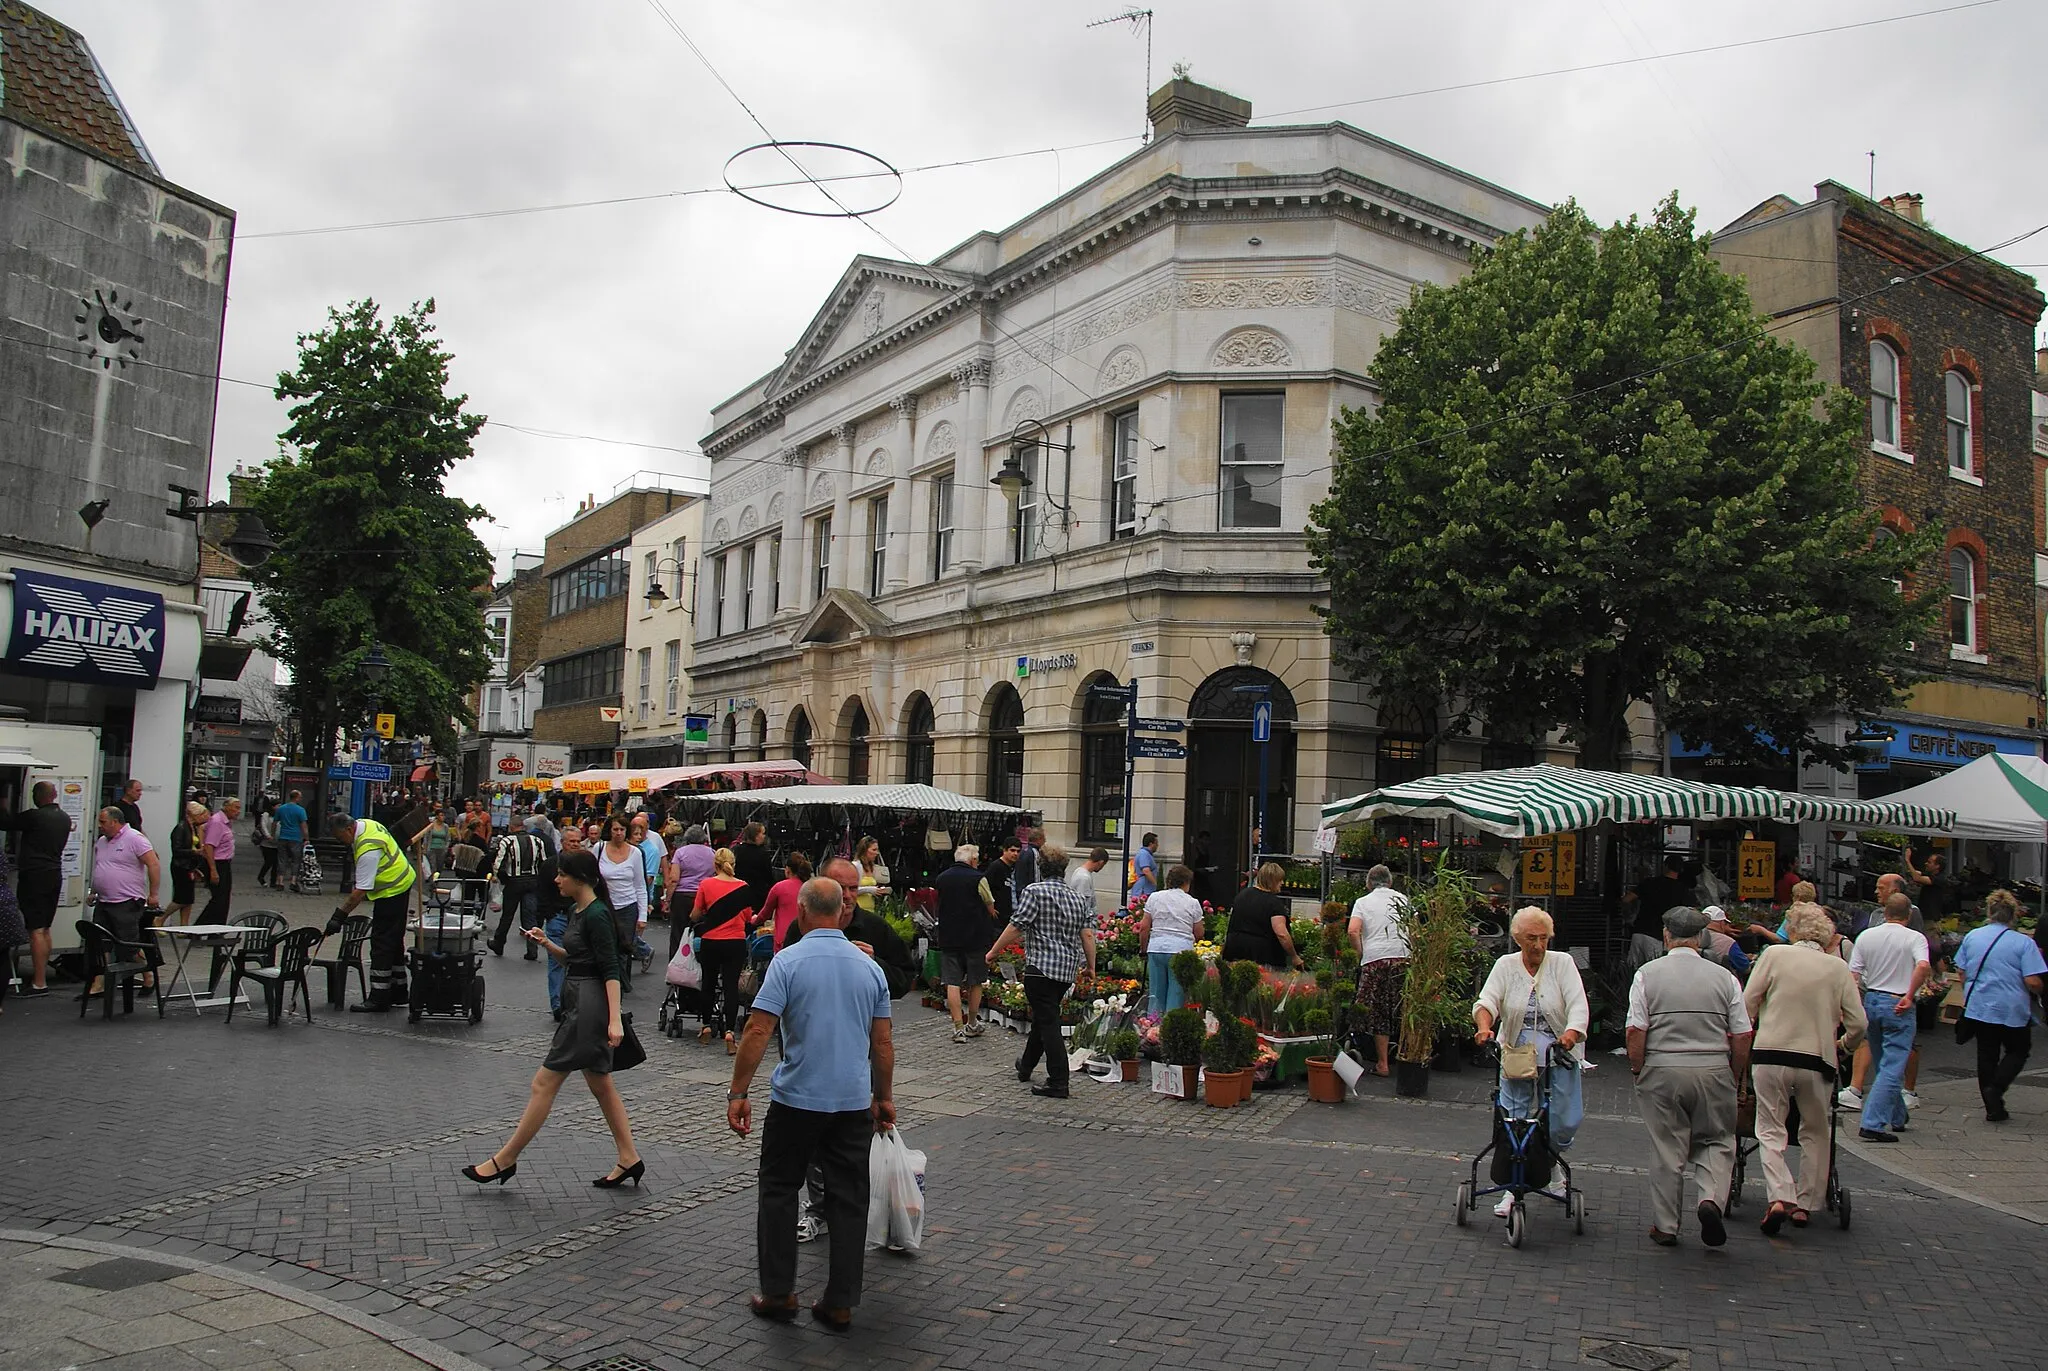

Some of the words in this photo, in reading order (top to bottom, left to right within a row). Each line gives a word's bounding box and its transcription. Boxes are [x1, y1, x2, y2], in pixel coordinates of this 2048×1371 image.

[24, 609, 157, 653] HALIFAX
[1030, 655, 1058, 674] Lloyds
[1059, 653, 1076, 668] TSB
[199, 705, 239, 715] HALIFAX
[356, 765, 386, 773] CYCLISTS
[499, 761, 522, 769] COB
[524, 779, 536, 787] SALE
[538, 780, 552, 788] SALE
[564, 780, 578, 789] SALE
[594, 781, 609, 791] SALE
[630, 779, 647, 789] SALE
[1527, 838, 1539, 846] All
[1542, 838, 1573, 847] Flers
[1751, 845, 1773, 853] Flowers
[1743, 858, 1764, 878] £1
[1528, 881, 1541, 890] Per
[1544, 881, 1570, 890] Bch
[1742, 885, 1752, 893] Per
[1752, 885, 1771, 893] Bunch
